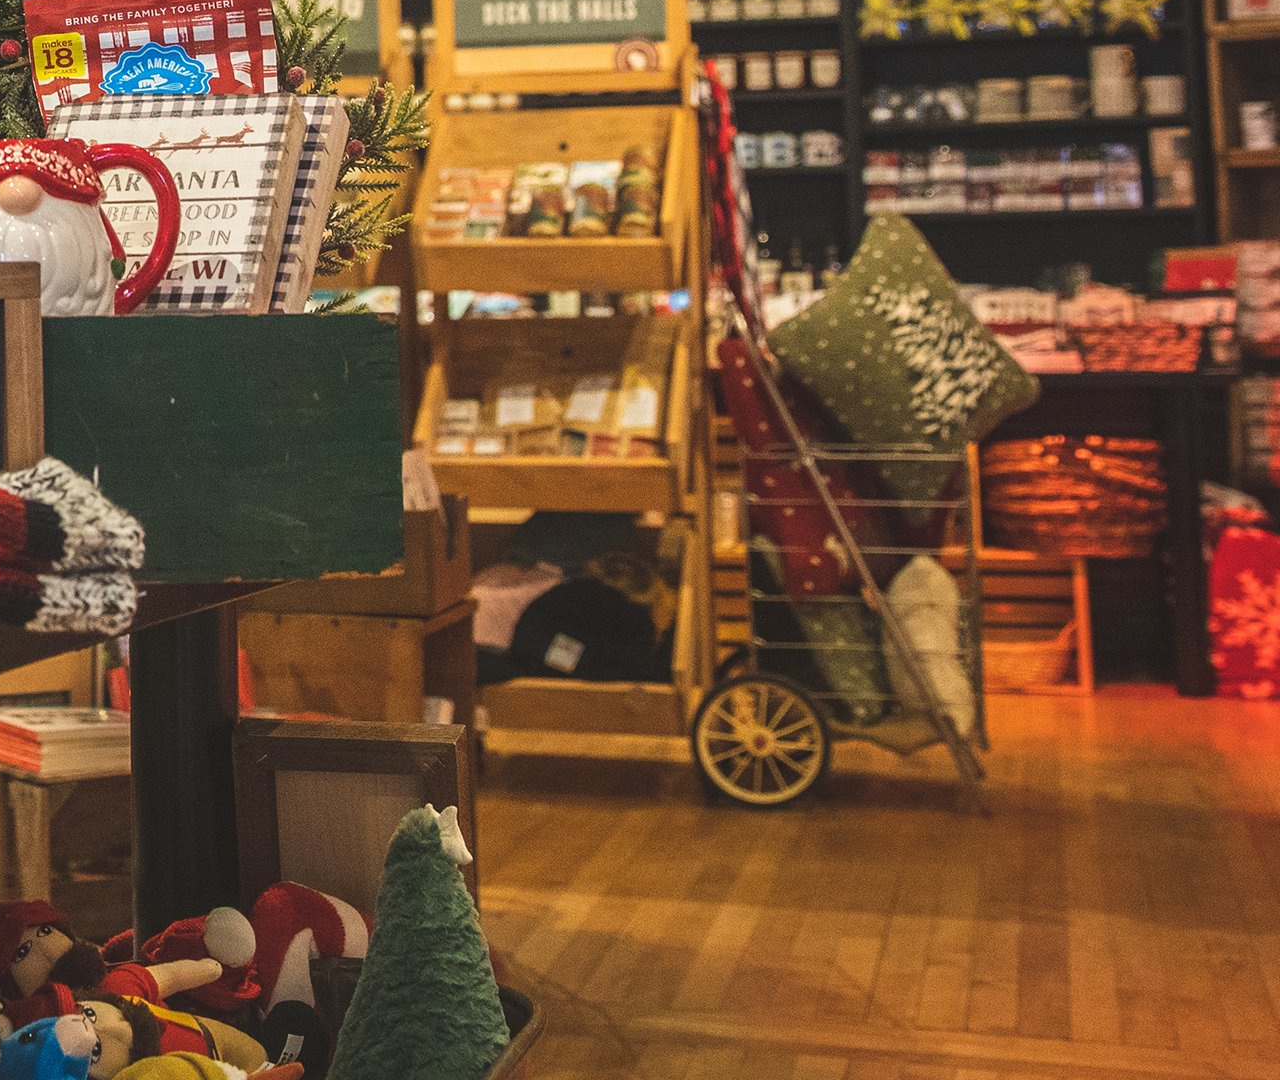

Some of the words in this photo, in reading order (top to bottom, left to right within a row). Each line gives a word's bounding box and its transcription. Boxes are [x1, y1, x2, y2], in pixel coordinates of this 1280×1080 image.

[65, 15, 99, 27] BRING
[102, 12, 124, 22] THE
[127, 7, 167, 20] FAMILY
[172, 0, 235, 15] TOGETHER!
[41, 39, 73, 48] makes
[43, 48, 75, 70] 18
[43, 68, 78, 76] PANCAKES
[173, 170, 240, 190] ANTA
[107, 203, 159, 222] BEEN
[184, 203, 238, 221] OOD
[208, 229, 233, 246] IN
[192, 259, 228, 280] WI
